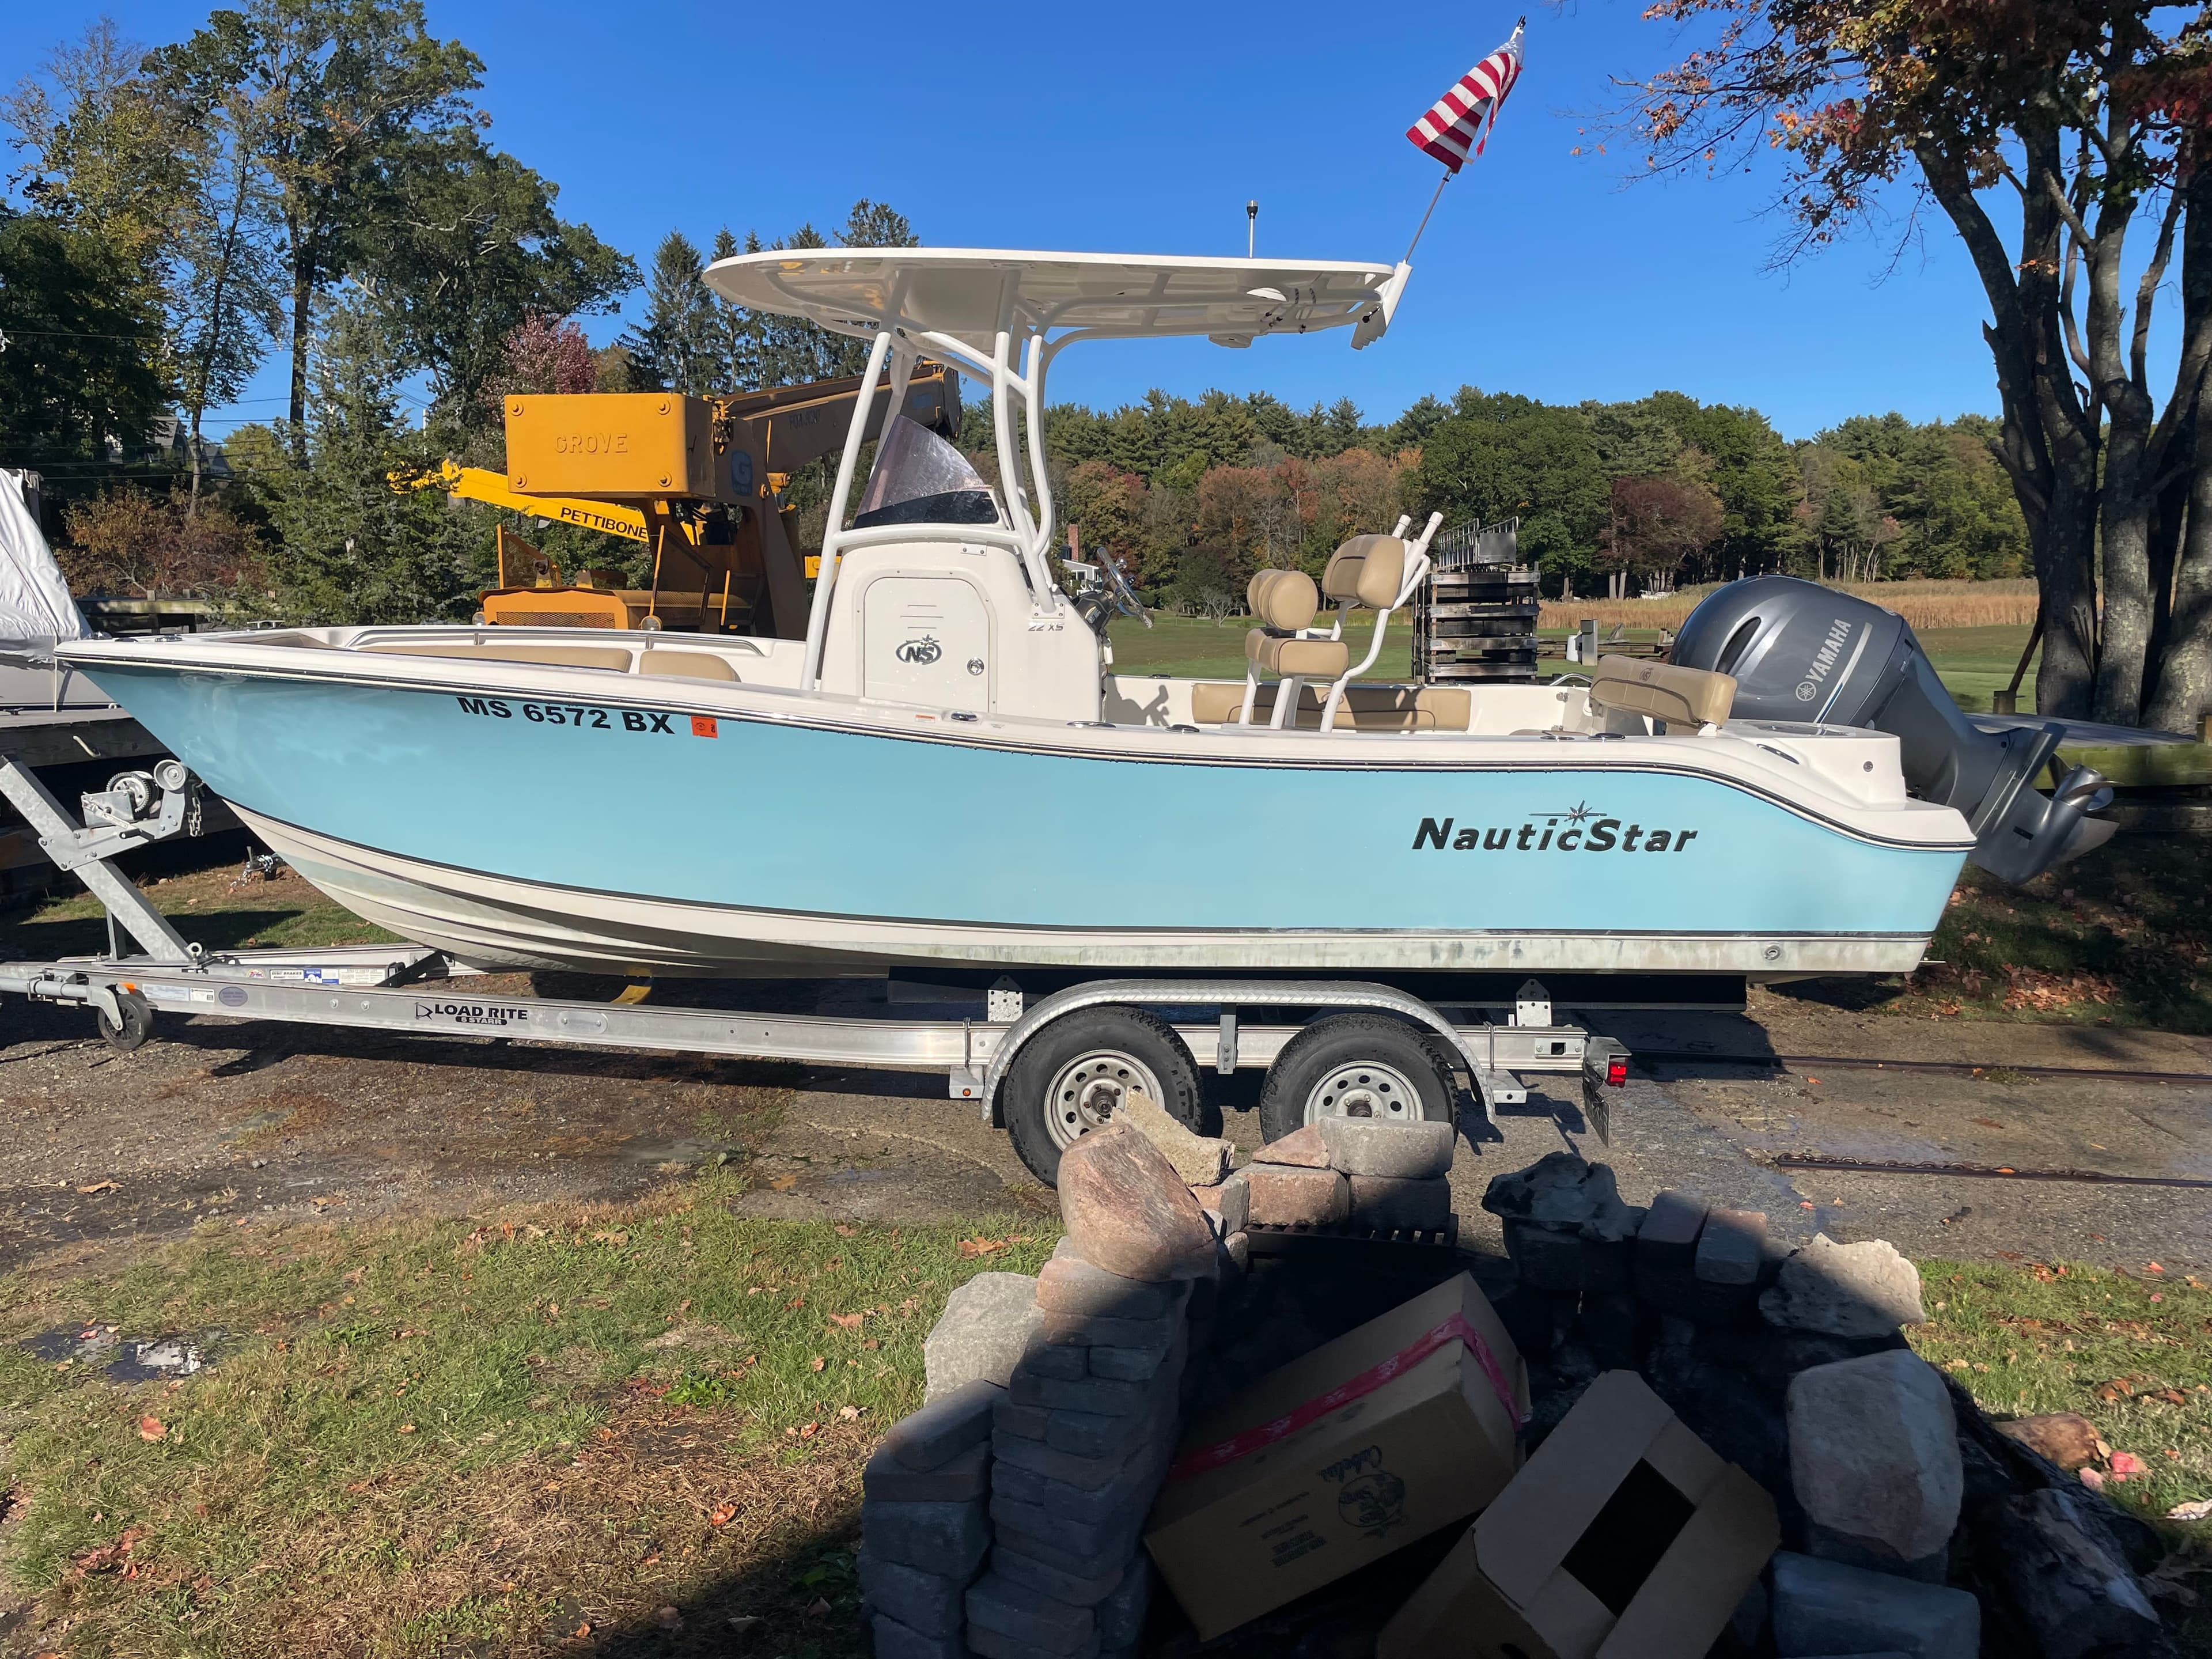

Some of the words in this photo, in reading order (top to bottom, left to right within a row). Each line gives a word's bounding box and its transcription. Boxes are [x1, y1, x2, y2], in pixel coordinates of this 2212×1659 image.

[554, 433, 628, 453] GROVE
[560, 507, 648, 539] PETTIBONE
[1028, 623, 1045, 632] 22
[1805, 619, 1851, 683] YAMAHA
[456, 696, 512, 718] MS
[522, 703, 611, 729] 6572
[621, 711, 676, 734] BX
[1411, 817, 1698, 852] NauticStar
[435, 1004, 483, 1017] LOAD
[488, 1007, 528, 1020] RITE
